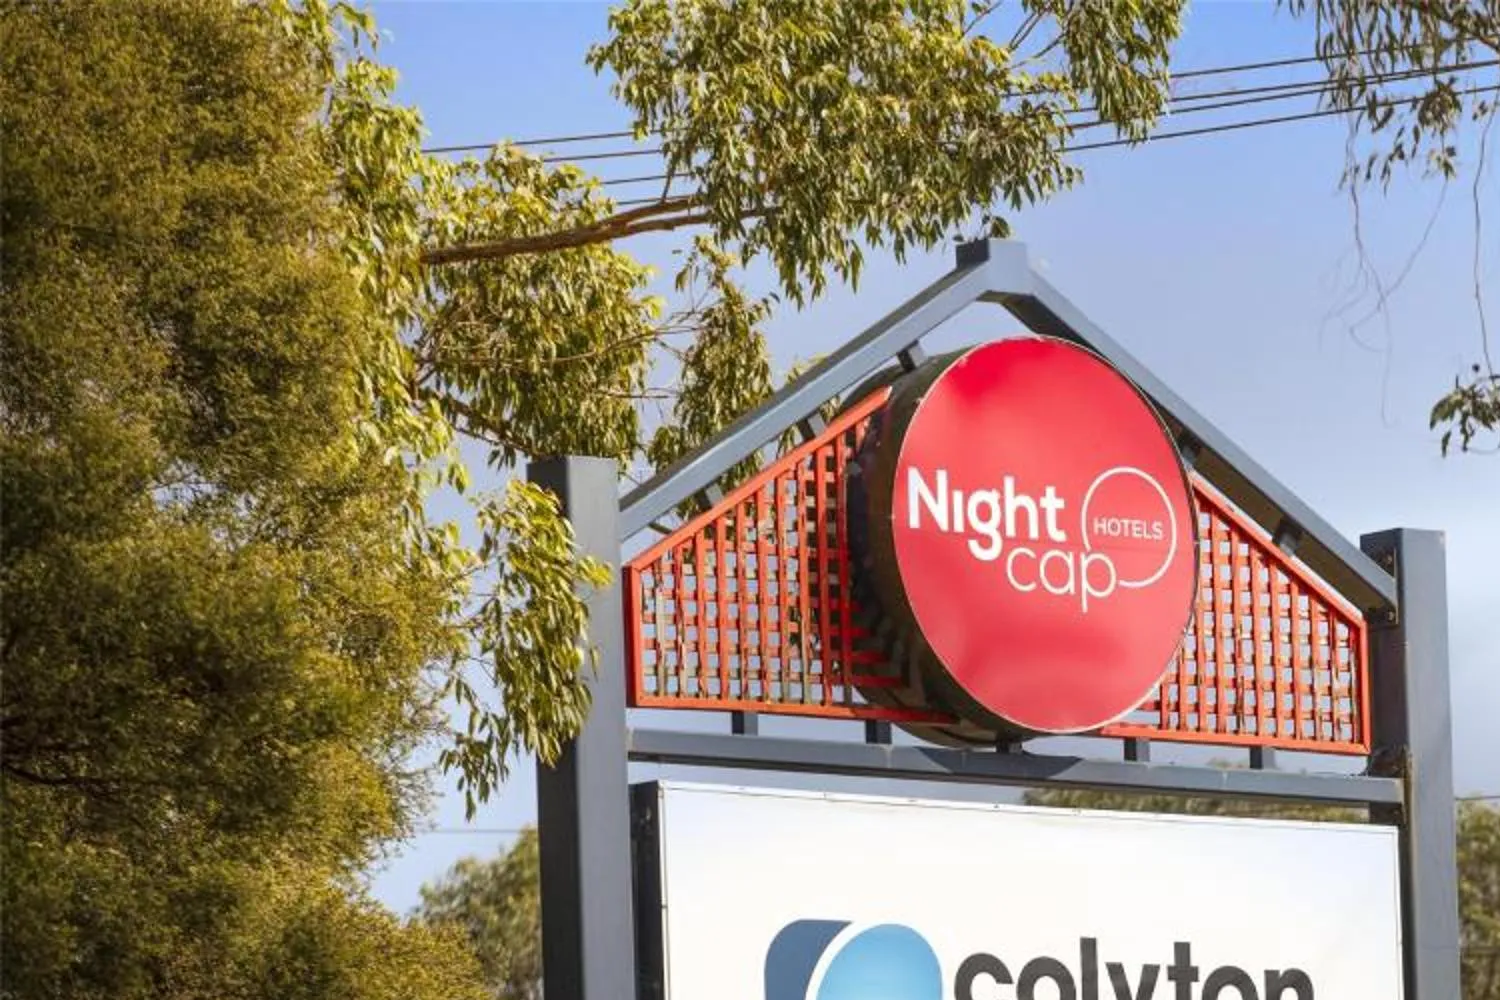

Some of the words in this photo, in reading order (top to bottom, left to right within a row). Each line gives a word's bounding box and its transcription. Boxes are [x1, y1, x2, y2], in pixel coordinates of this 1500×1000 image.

[906, 466, 1068, 561] Night
[1093, 516, 1165, 541] HOTELS
[1006, 547, 1118, 614] cap
